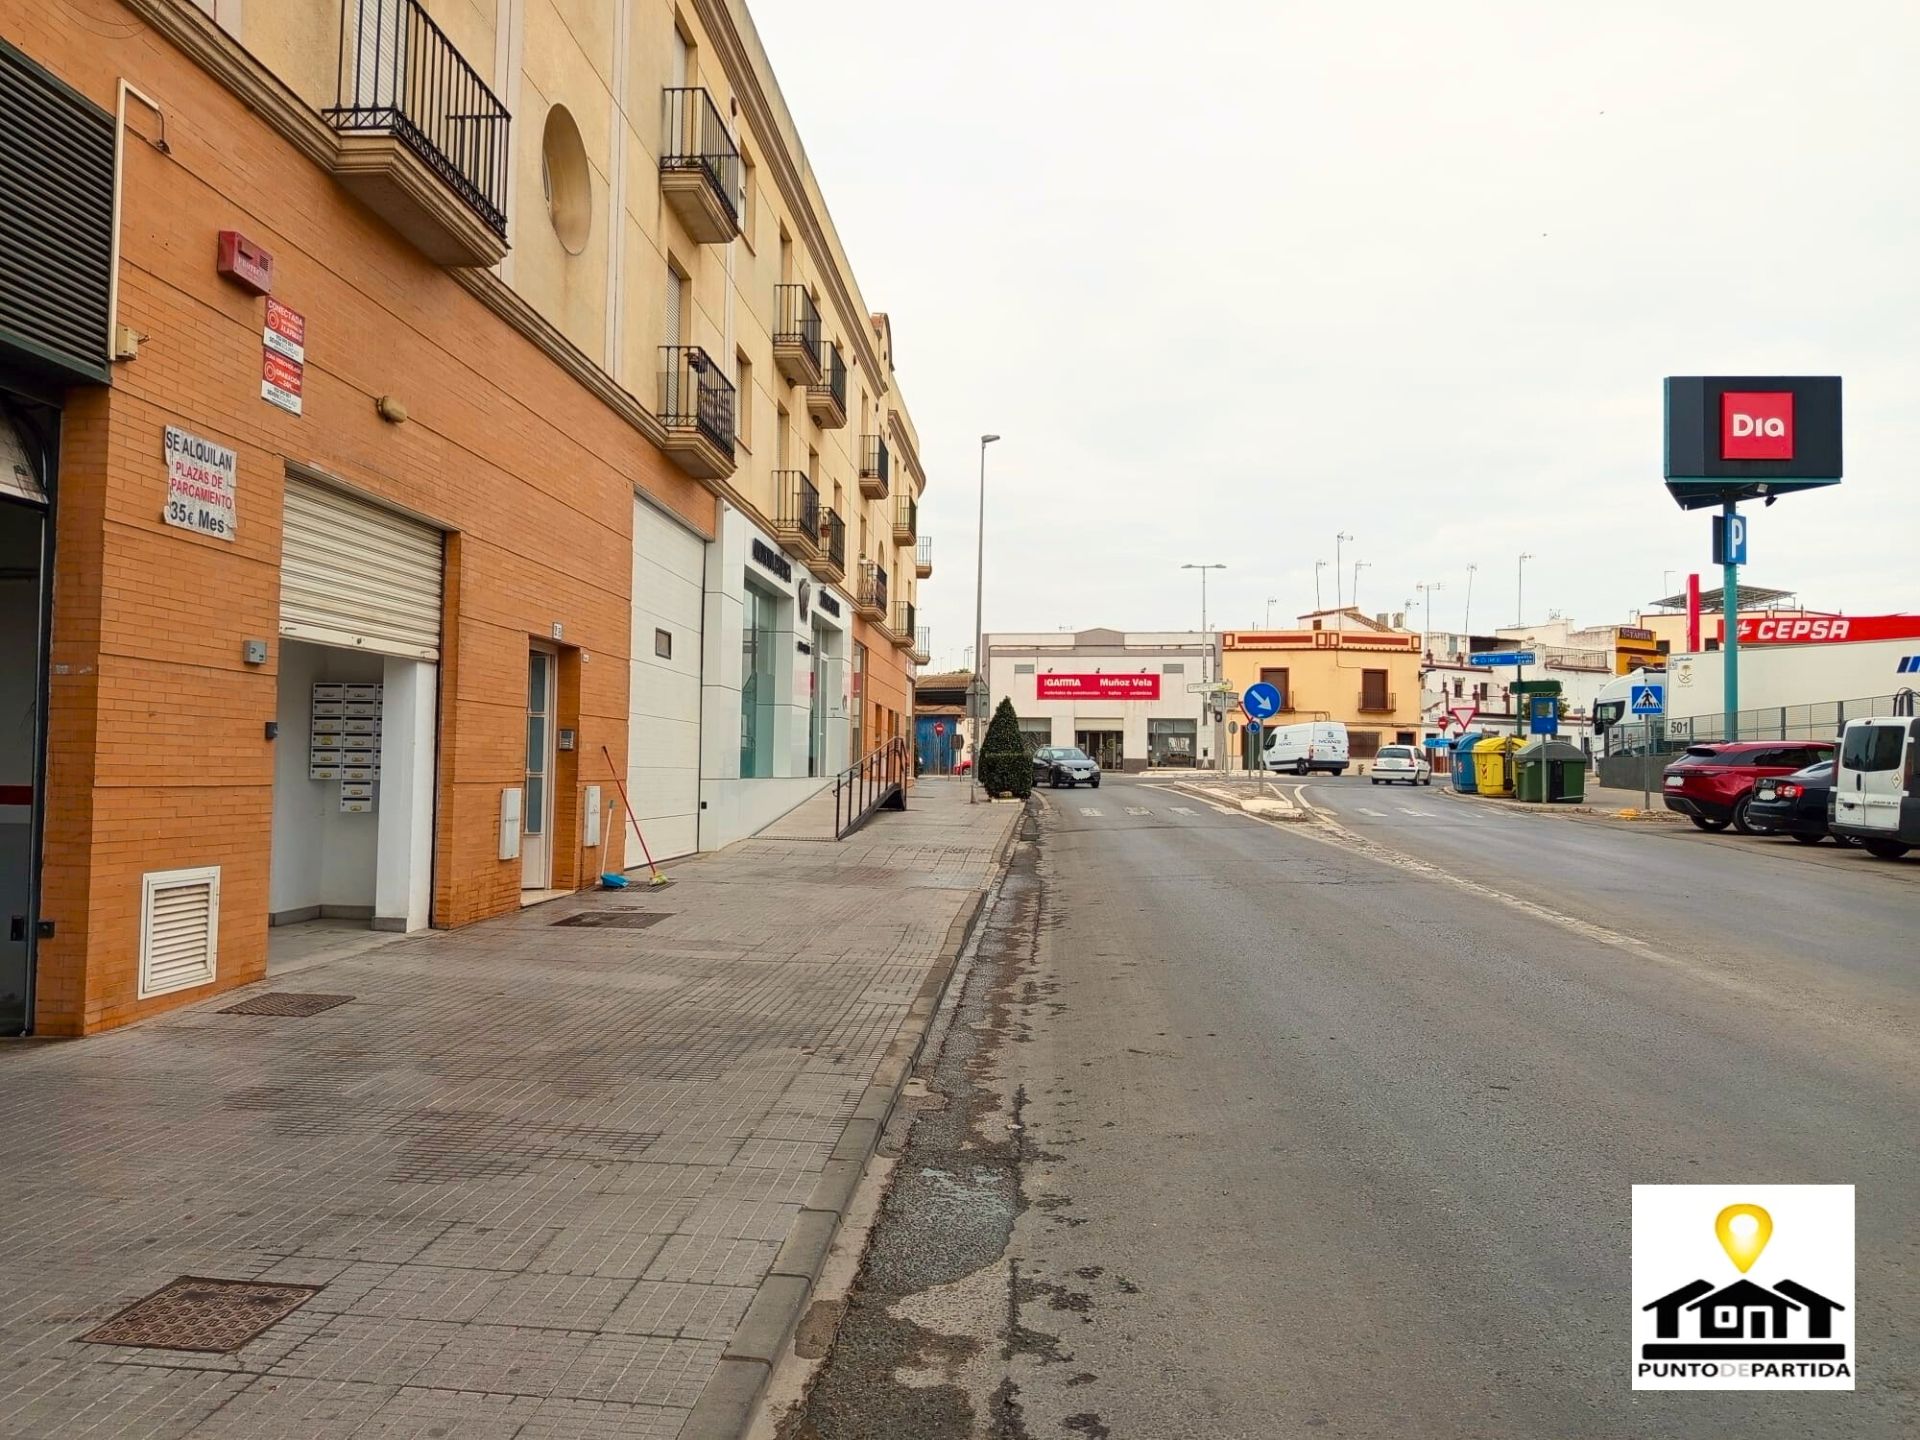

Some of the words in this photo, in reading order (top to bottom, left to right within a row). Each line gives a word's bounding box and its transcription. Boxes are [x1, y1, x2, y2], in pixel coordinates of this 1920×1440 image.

[165, 431, 180, 452] SE
[181, 438, 233, 472] ALQUILAN
[175, 461, 209, 485] PLAZAS
[211, 474, 224, 490] DE
[170, 478, 232, 510] PARCAMIENTO
[170, 501, 194, 525] 35€
[198, 509, 225, 533] Mes
[1731, 518, 1744, 559] P
[1757, 620, 1850, 640] CEPSA
[1100, 678, 1130, 687] Muñoz
[1132, 678, 1153, 687] Vela
[1670, 721, 1689, 734] 501
